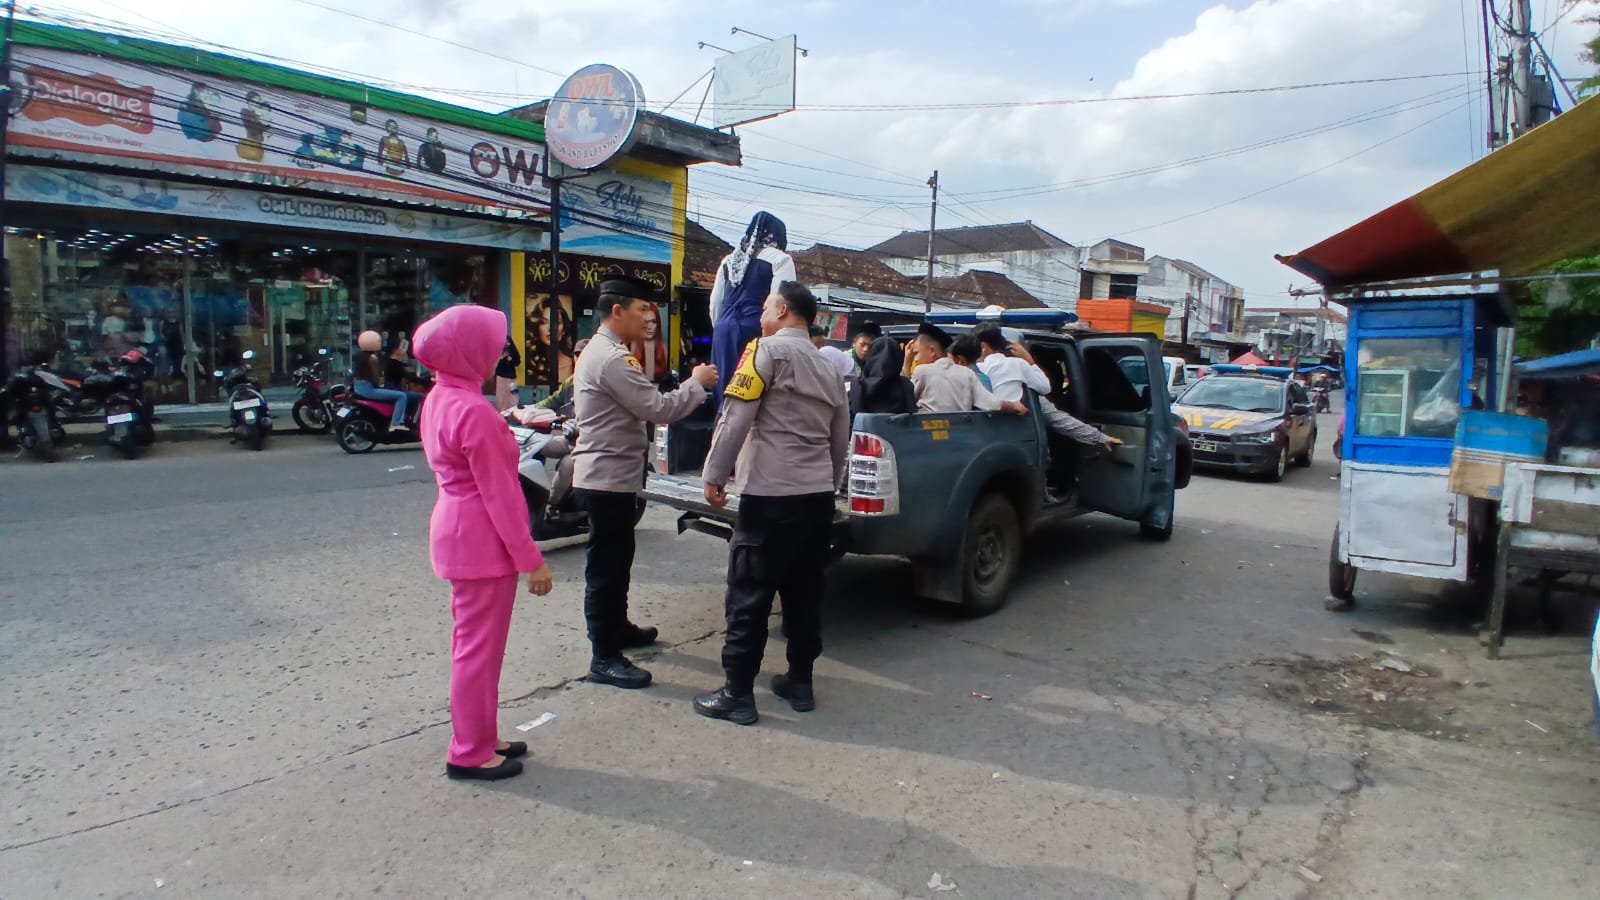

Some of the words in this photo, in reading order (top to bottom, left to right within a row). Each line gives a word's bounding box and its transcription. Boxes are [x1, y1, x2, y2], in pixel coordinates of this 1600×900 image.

[33, 80, 143, 112] Dialogue
[568, 73, 617, 100] OWL
[258, 197, 296, 215] OWL
